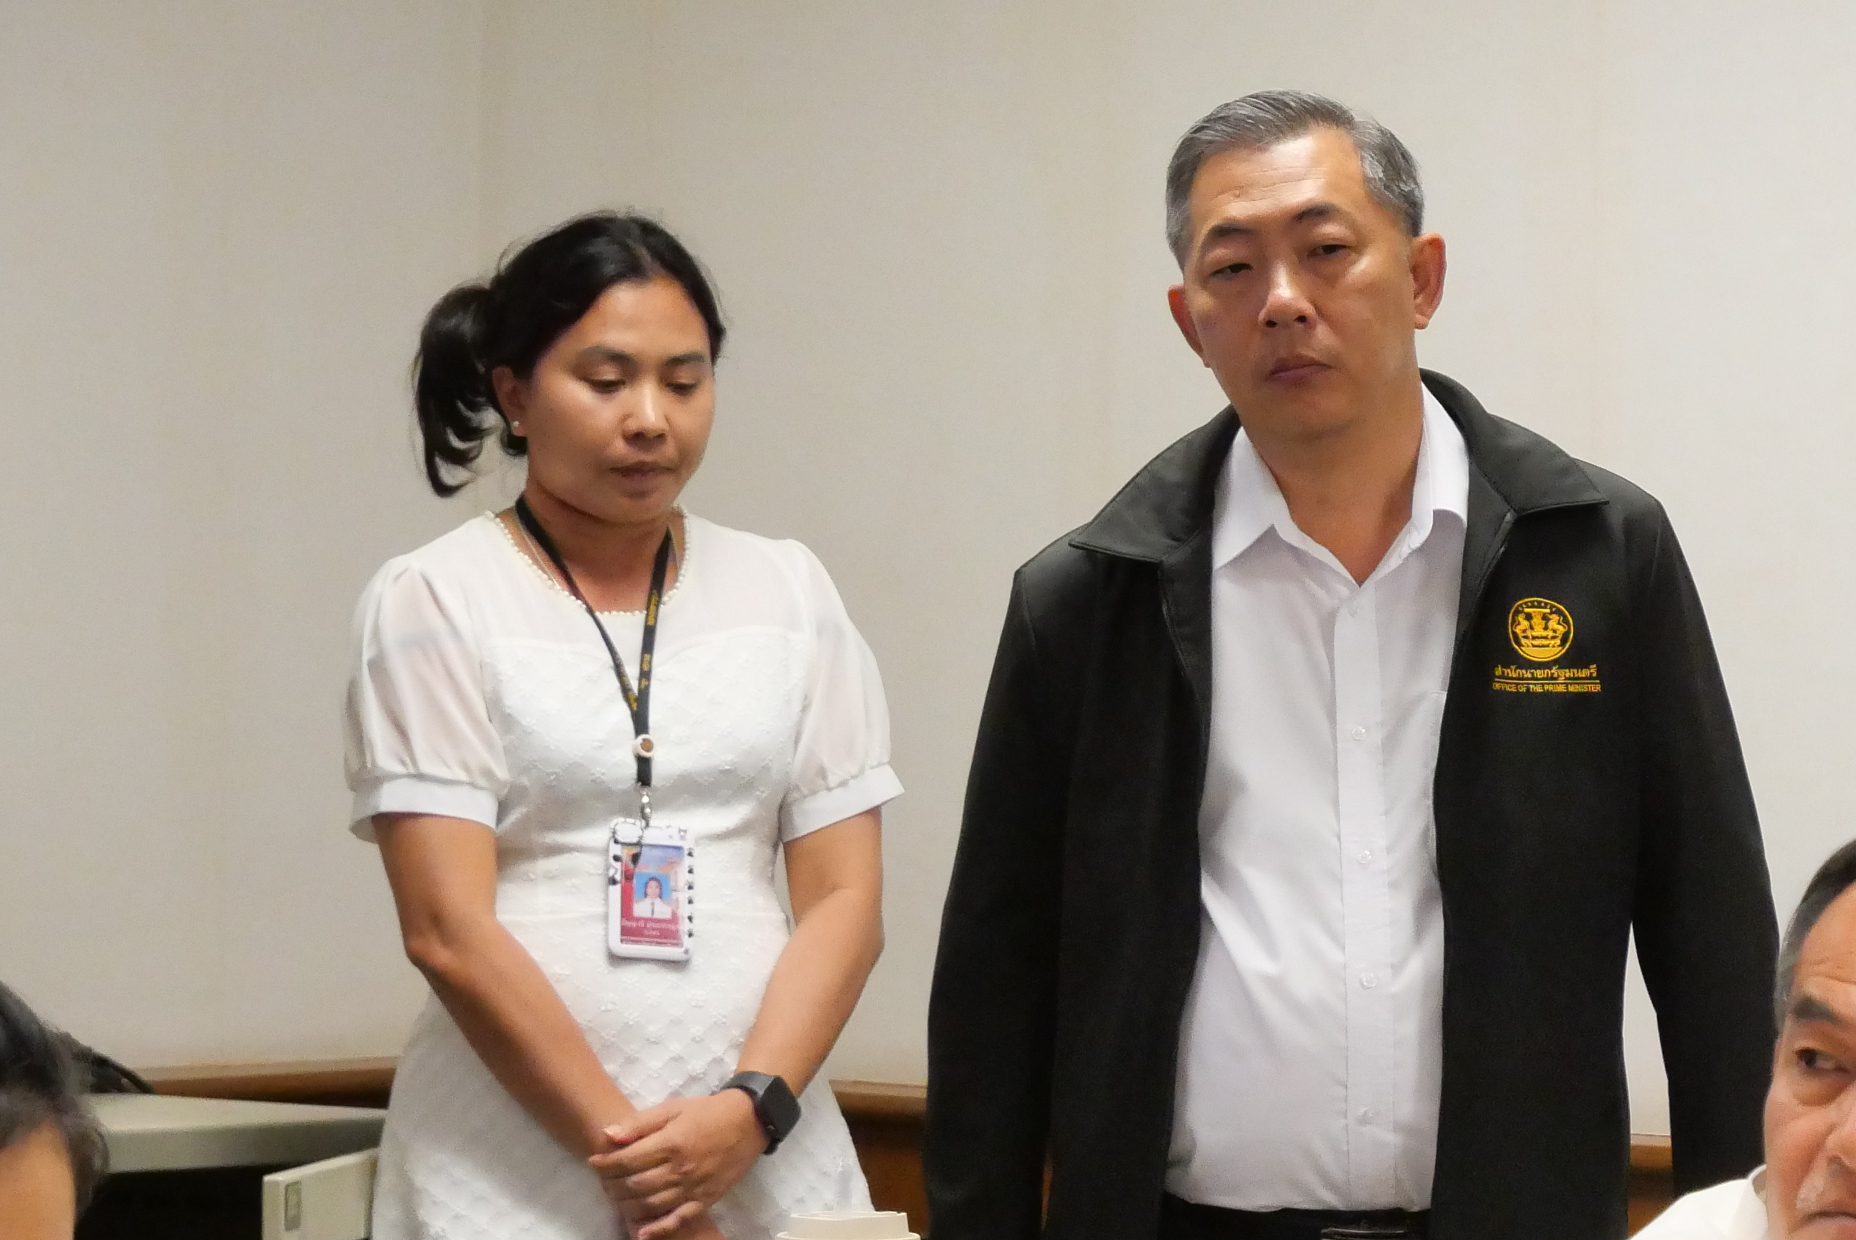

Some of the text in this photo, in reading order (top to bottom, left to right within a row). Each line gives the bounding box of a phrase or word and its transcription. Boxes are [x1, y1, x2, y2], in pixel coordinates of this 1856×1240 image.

[1492, 682, 1601, 692] OFFICE OF THE PRIME MINISTER
